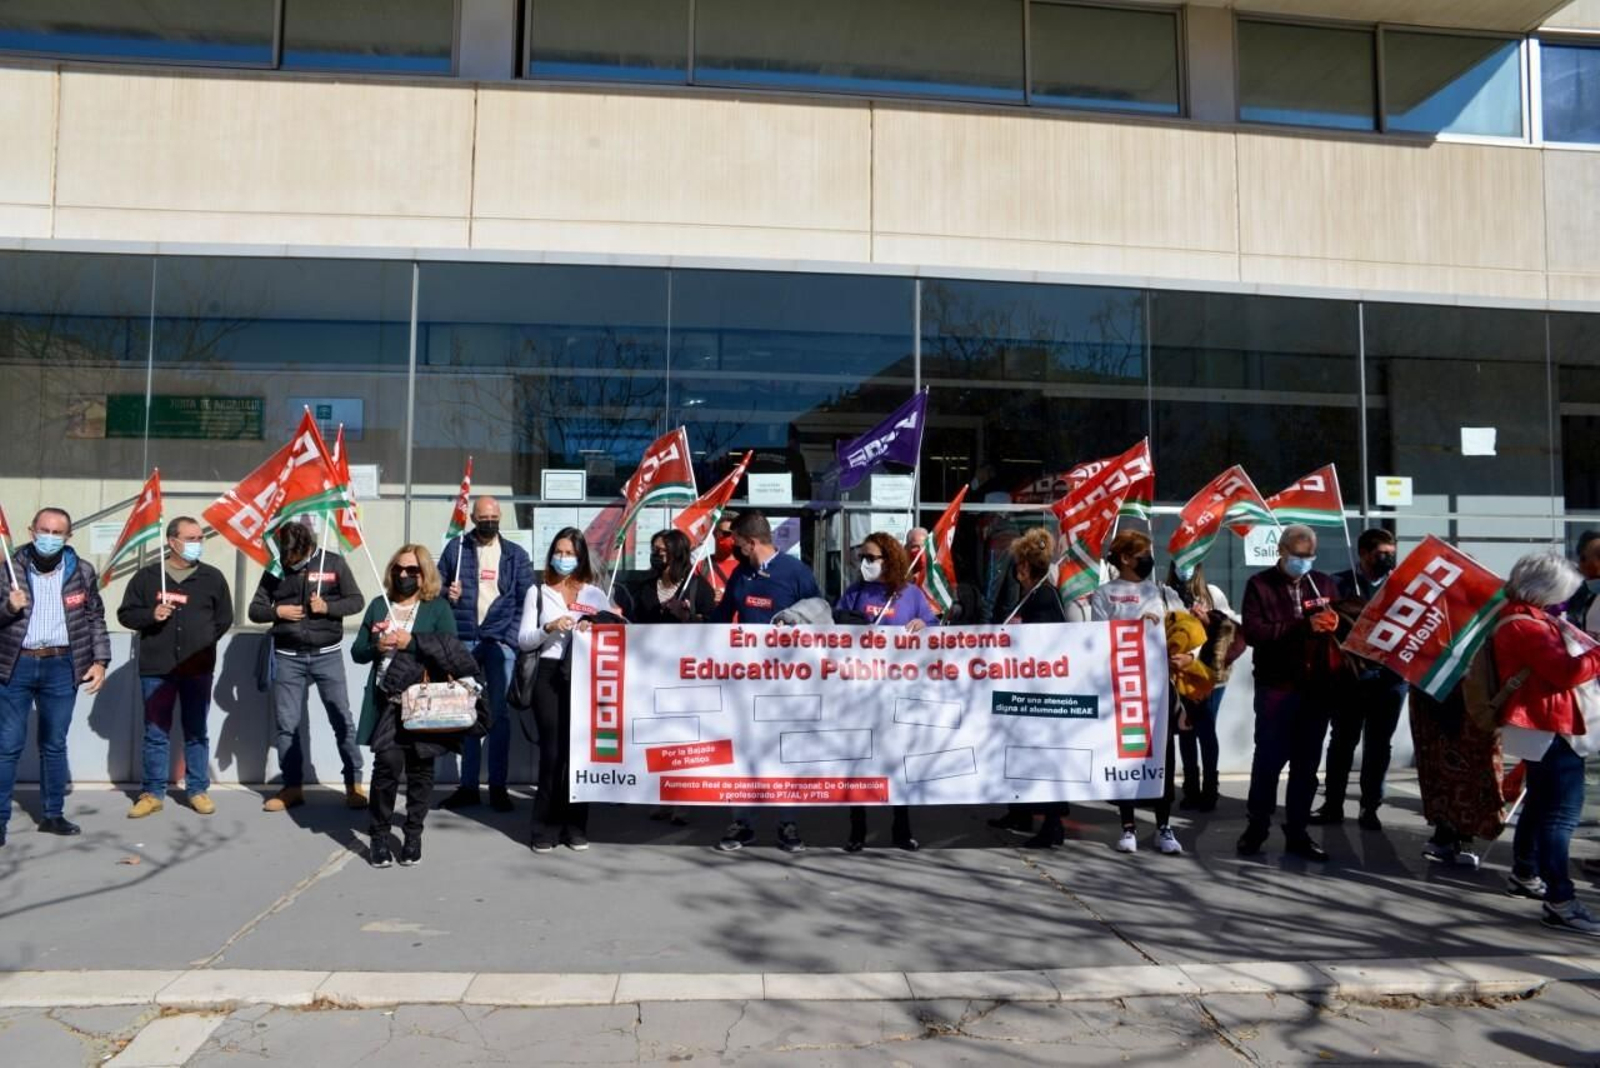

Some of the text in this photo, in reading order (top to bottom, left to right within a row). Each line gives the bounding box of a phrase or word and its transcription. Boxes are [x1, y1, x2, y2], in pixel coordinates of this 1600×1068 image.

[729, 628, 1012, 650] En defensa de un sistema
[679, 656, 1070, 681] Educativo Público de Calidad
[1116, 626, 1144, 724] CCOO
[596, 631, 620, 729] CCOO
[1011, 694, 1079, 706] Por una atención
[995, 704, 1018, 713] digna
[1029, 705, 1069, 715] alumnado
[1070, 707, 1094, 715] NEAE
[661, 745, 716, 758] Por la Bajada
[671, 758, 682, 766] de
[575, 769, 637, 786] Huelva
[664, 780, 700, 789] Aumento
[701, 780, 721, 789] Real
[721, 781, 733, 789] de
[734, 781, 771, 791] plantillas
[773, 781, 783, 790] de
[824, 782, 836, 790] De
[837, 781, 885, 790] Orientación
[725, 790, 775, 800] profesorado
[776, 790, 801, 799] PT/AL
